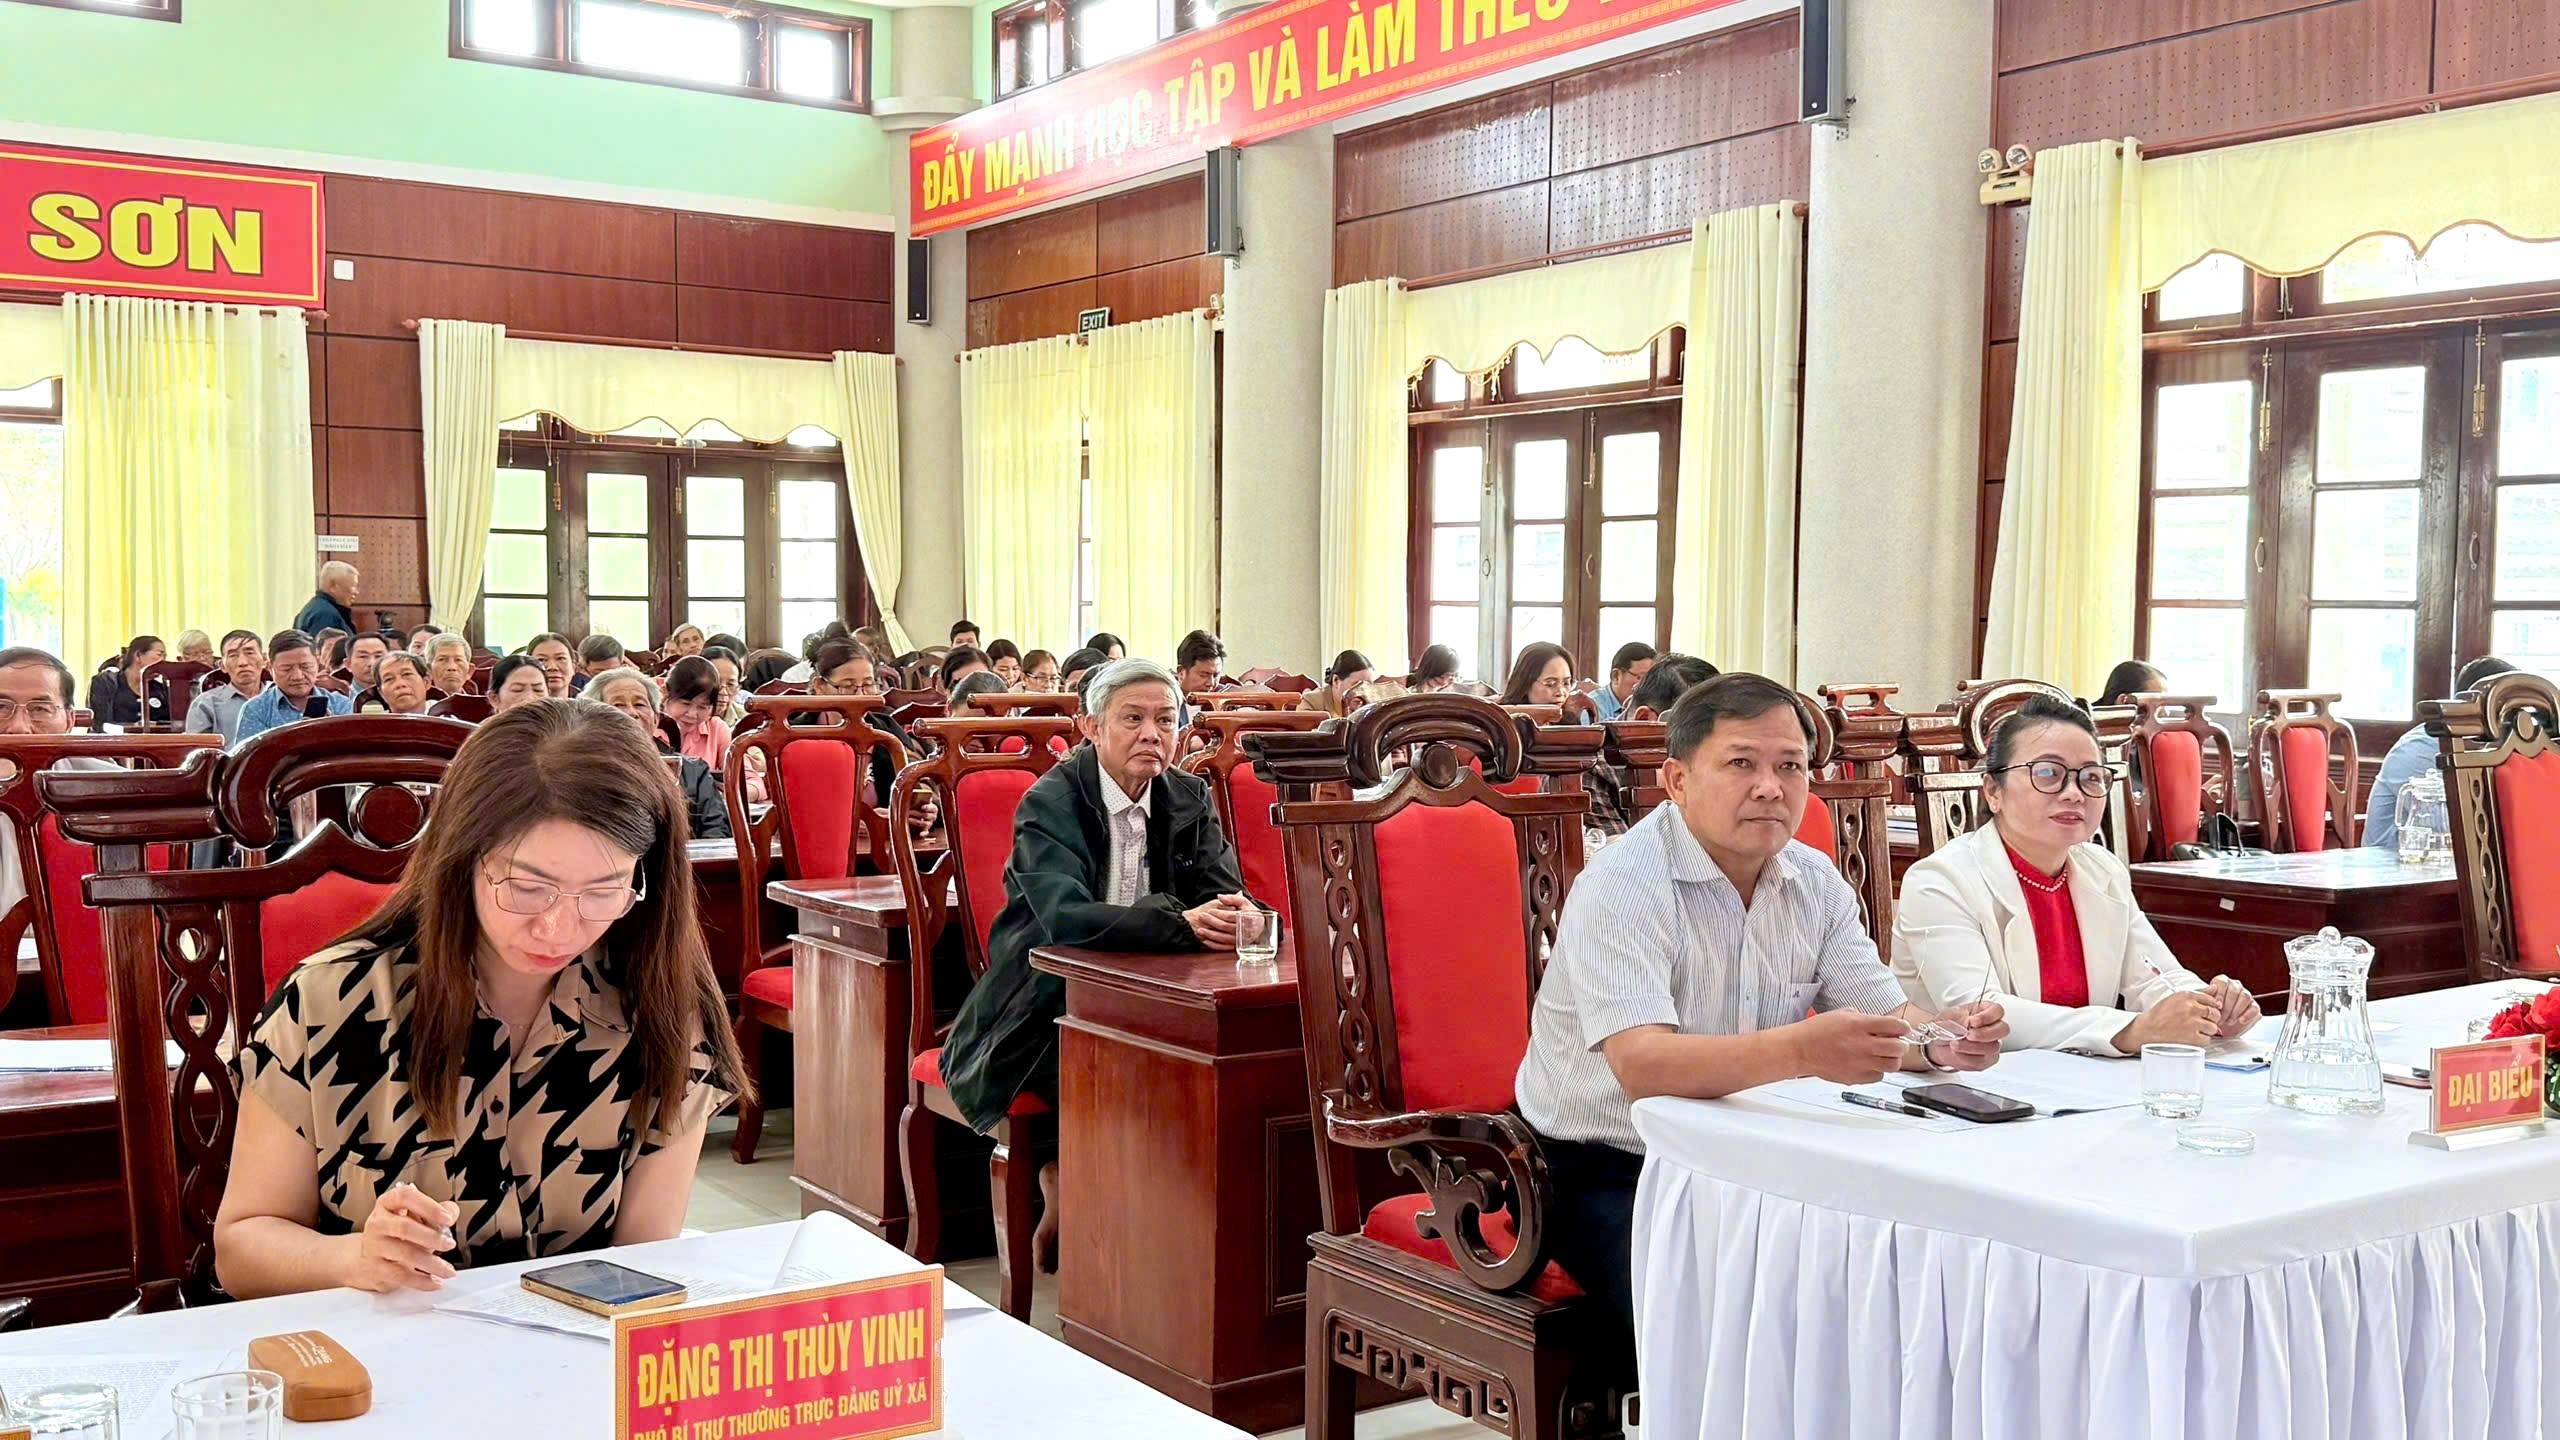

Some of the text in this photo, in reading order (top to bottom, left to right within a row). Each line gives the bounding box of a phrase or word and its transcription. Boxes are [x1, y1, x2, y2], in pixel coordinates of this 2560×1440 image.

[923, 131, 976, 211] ĐẨY
[984, 116, 1075, 197] MẠNH
[1085, 88, 1150, 167] HỌC
[1164, 58, 1236, 145] TẬP
[1248, 24, 1302, 112] VÀ
[1316, 0, 1416, 92] LÀM
[27, 191, 263, 276] SƠN
[1082, 313, 1104, 330] EXIT
[2448, 1054, 2533, 1113] ĐẠI BIỂU
[637, 1307, 925, 1416] ĐẶNG THỊ THÙY VINH
[728, 1404, 791, 1438] THƯỜNG
[794, 1396, 834, 1427] TRỰC
[838, 1385, 880, 1417] ĐẢNG
[907, 1375, 928, 1404] XÃ
